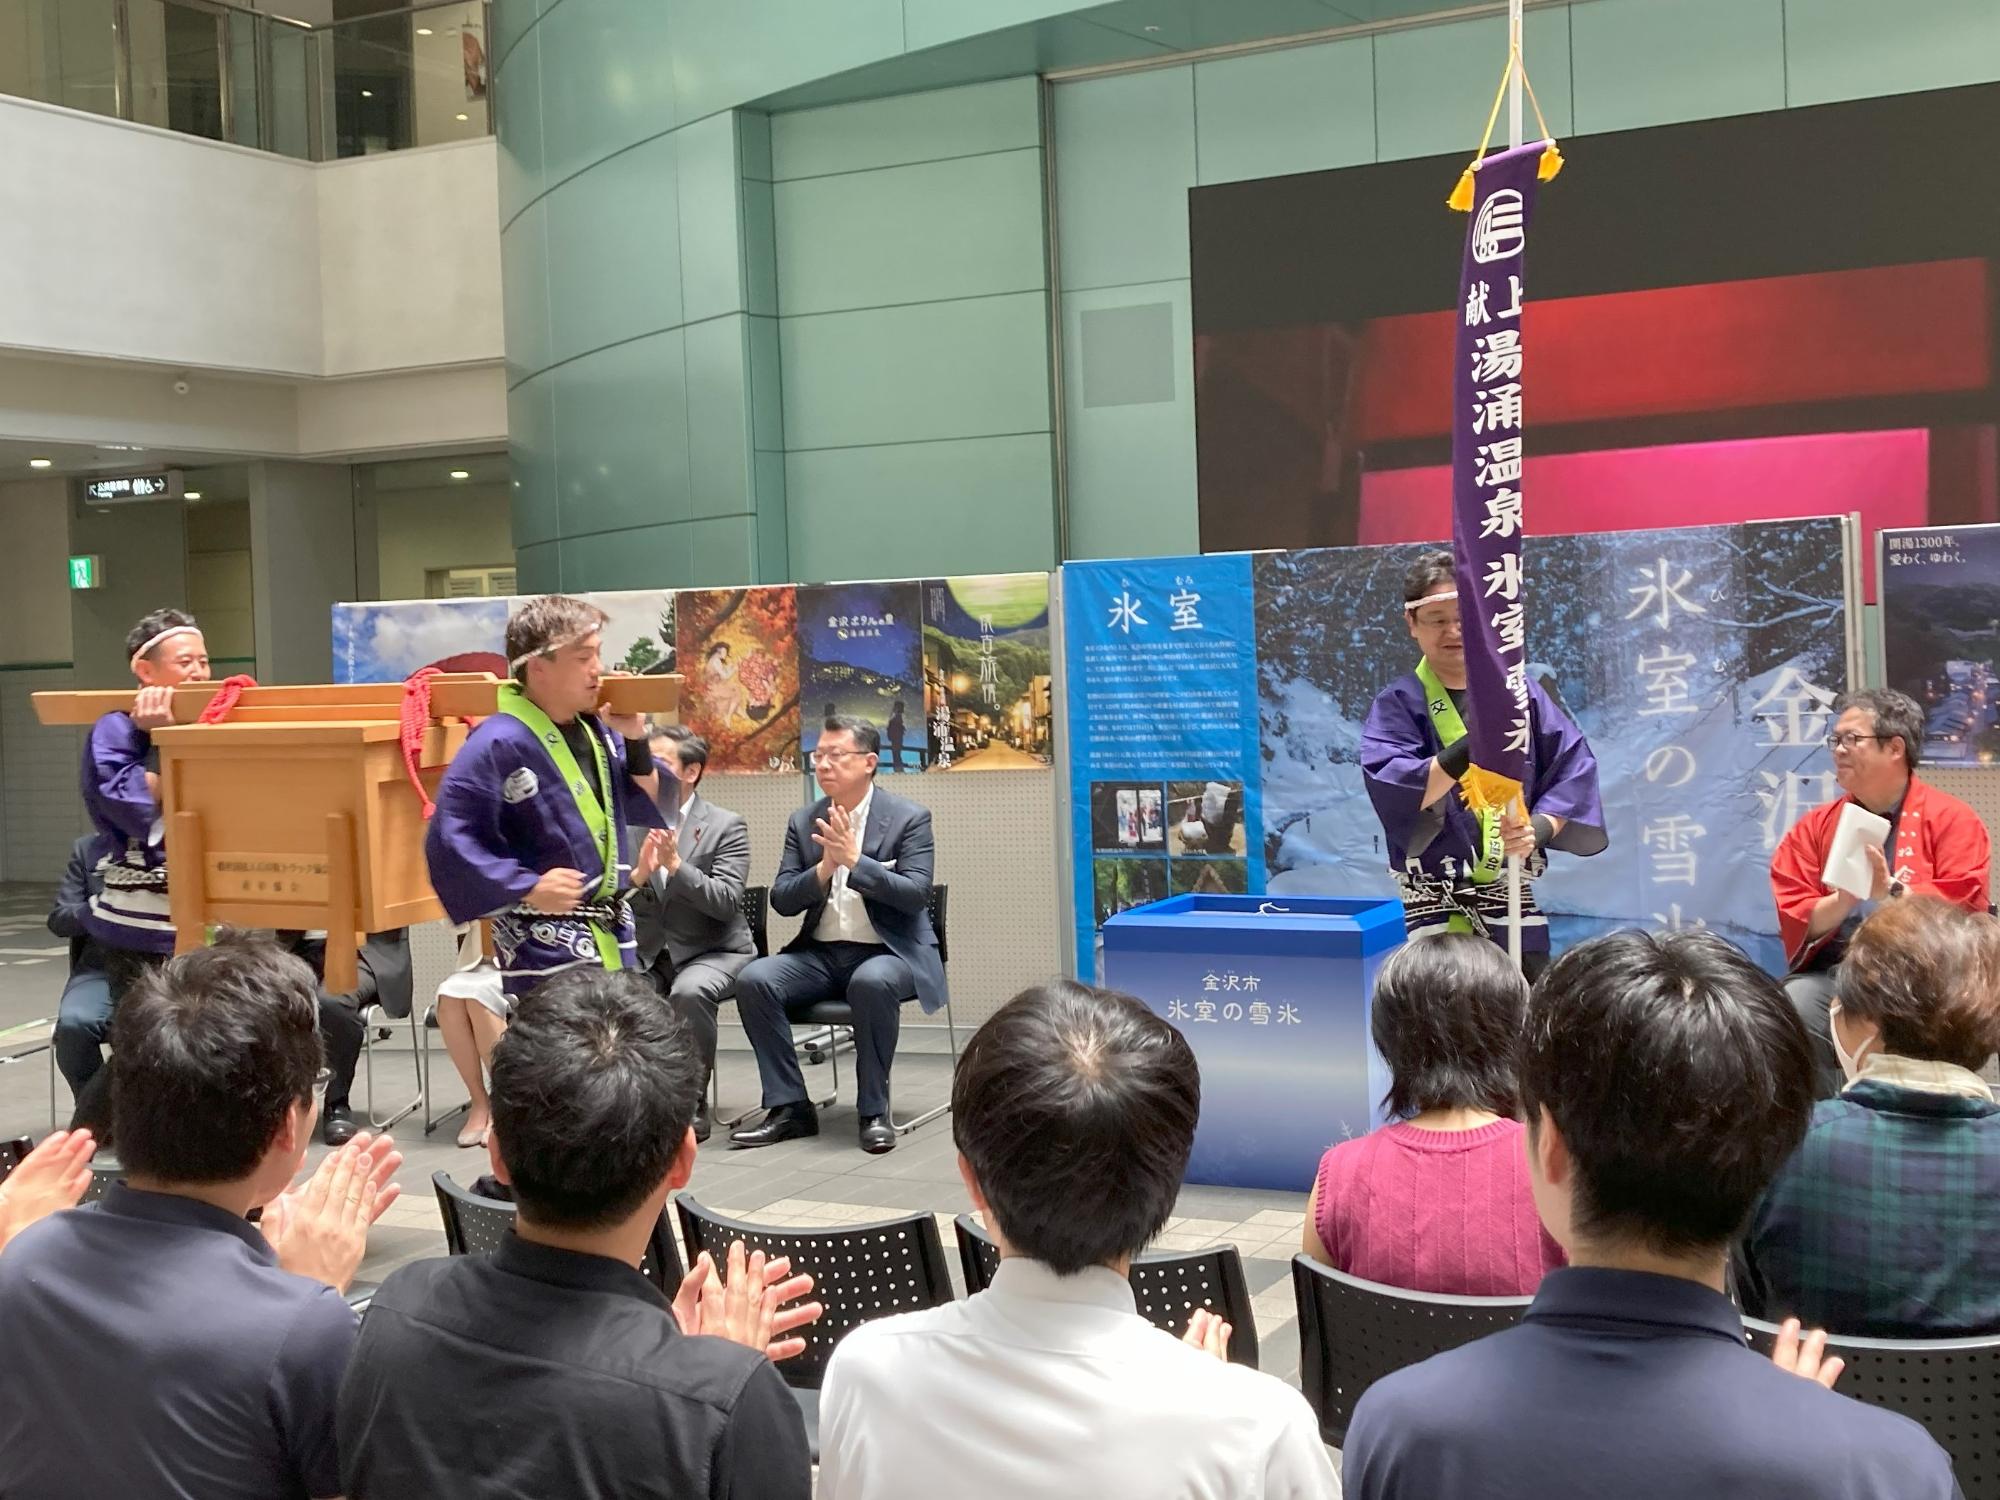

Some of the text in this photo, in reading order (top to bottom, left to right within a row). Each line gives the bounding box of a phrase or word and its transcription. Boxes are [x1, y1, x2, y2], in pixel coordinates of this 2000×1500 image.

[1471, 329, 1523, 538] 湯涌温泉
[1174, 575, 1194, 586] むろ
[1107, 588, 1204, 634] 氷室
[1202, 973, 1261, 992] 金沢市
[1167, 999, 1302, 1025] 氷室の雪氷
